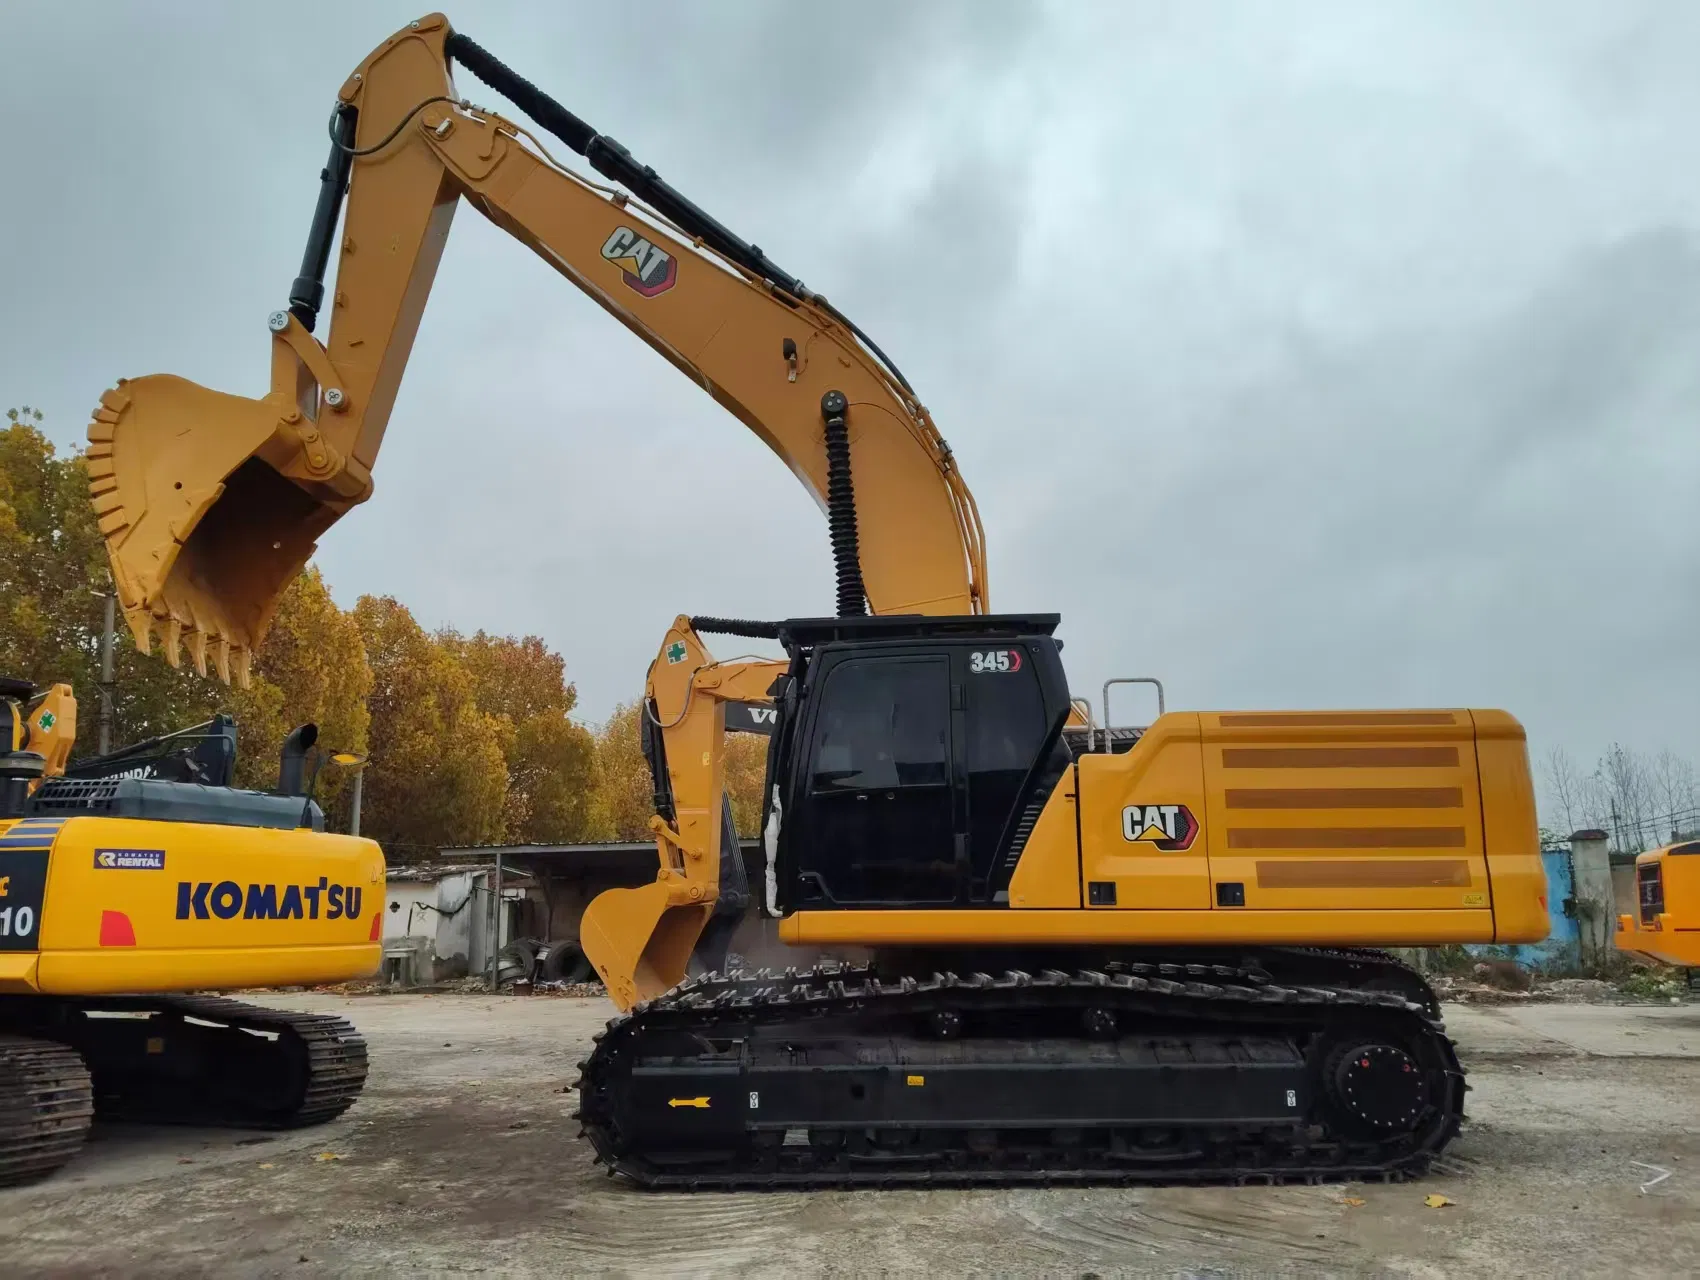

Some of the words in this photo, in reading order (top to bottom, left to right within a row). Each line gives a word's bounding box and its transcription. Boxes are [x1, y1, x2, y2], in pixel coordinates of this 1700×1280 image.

[601, 227, 670, 282] CAT
[971, 651, 1009, 672] 345
[1122, 805, 1178, 840] CAT
[117, 857, 161, 867] RENTAL
[175, 876, 362, 920] KOMATSU
[0, 906, 33, 936] 10
